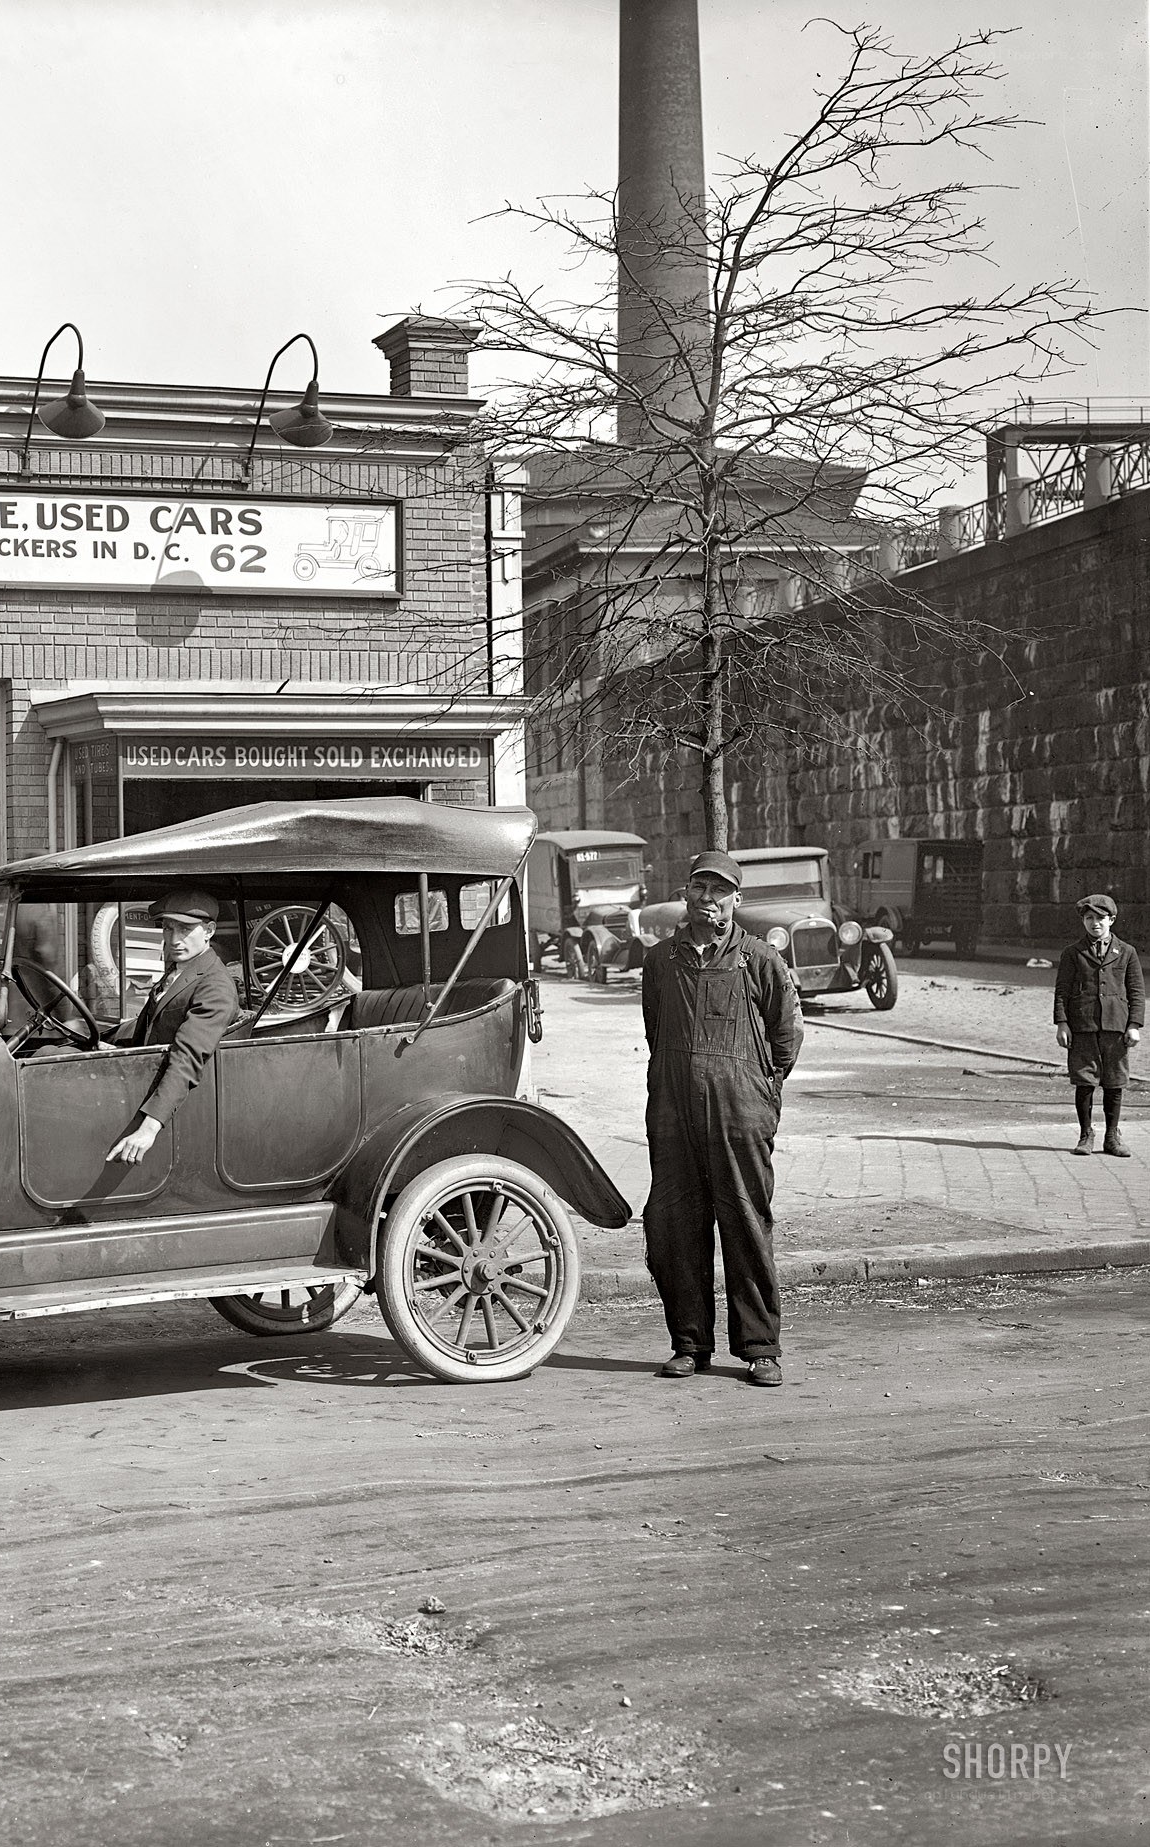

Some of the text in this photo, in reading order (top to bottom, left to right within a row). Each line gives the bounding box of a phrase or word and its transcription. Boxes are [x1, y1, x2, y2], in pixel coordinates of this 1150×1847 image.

[36, 503, 129, 532] USED
[150, 505, 263, 536] CARS
[93, 541, 117, 560] IN
[210, 544, 267, 573] 62
[127, 747, 482, 768] USED CARS BOUGHT SOLD EXCHANGED
